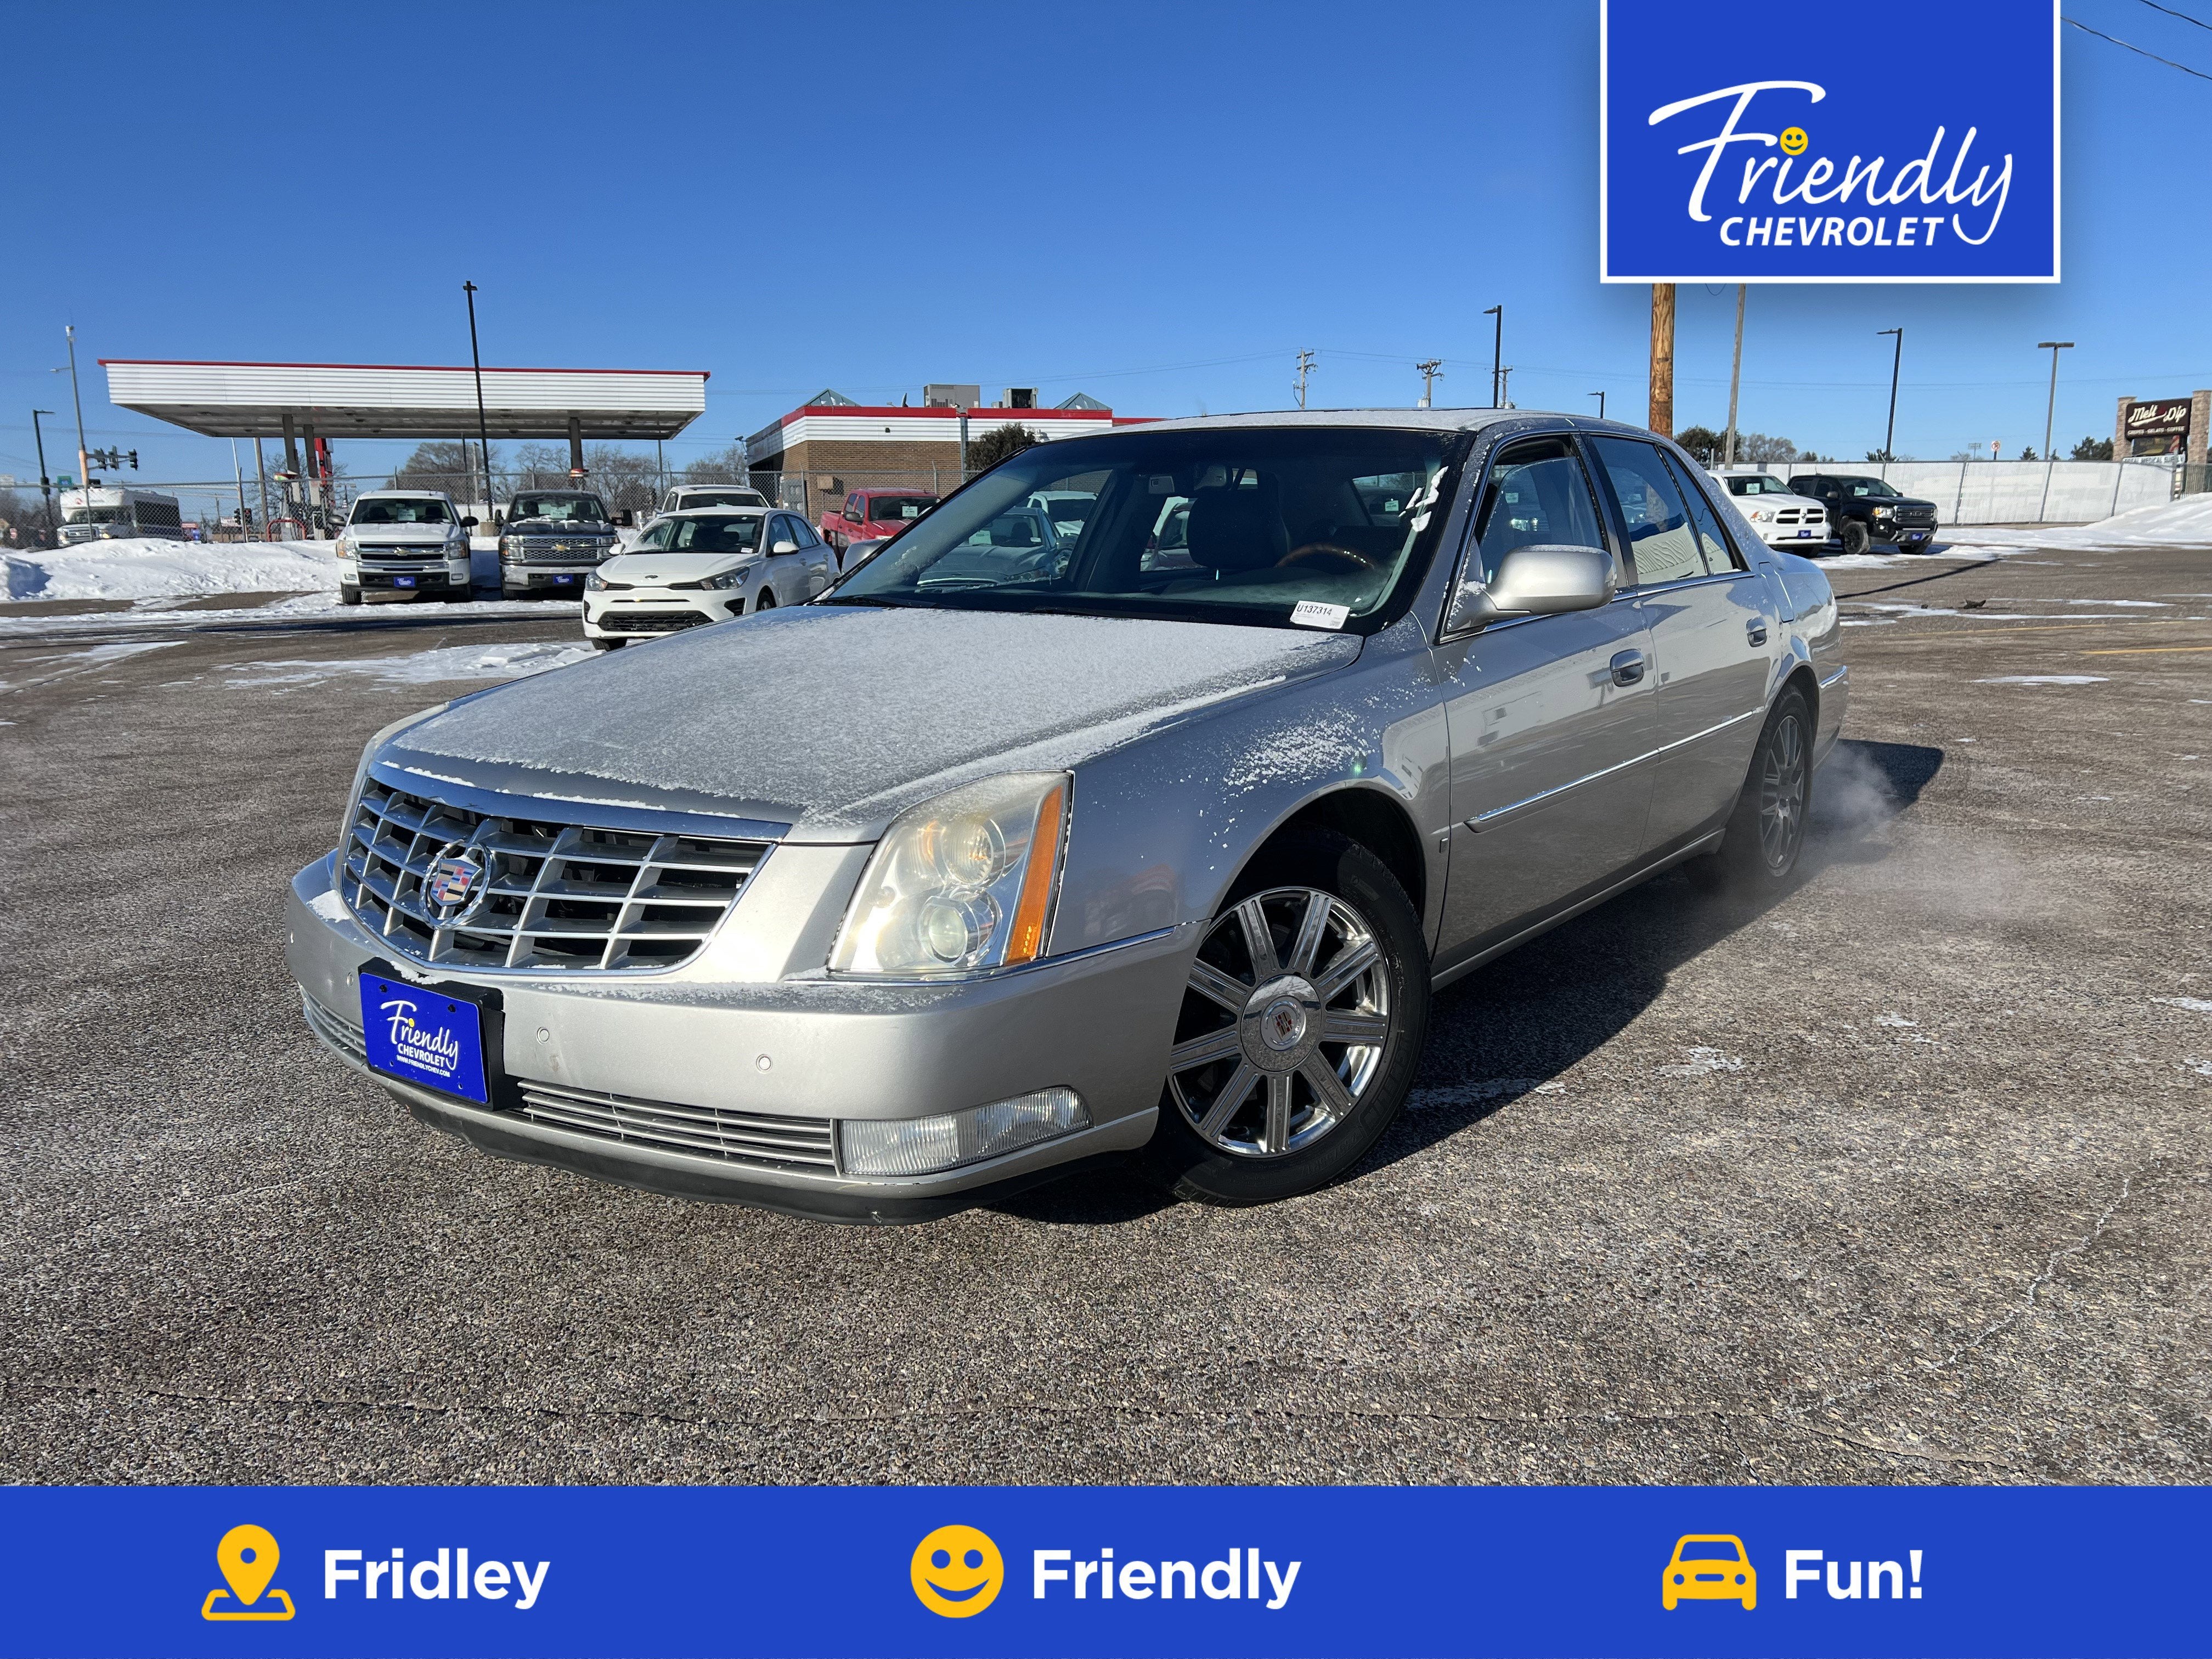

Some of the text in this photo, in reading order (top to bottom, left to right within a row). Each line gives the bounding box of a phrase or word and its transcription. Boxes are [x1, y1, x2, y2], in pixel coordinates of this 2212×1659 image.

[2163, 405, 2186, 423] Dip
[1297, 604, 1333, 616] U137314
[381, 1000, 459, 1070] Friendly
[397, 1054, 451, 1077] WWW.FRIENDLYCHEV.COM
[398, 1043, 445, 1068] CHEVROLET
